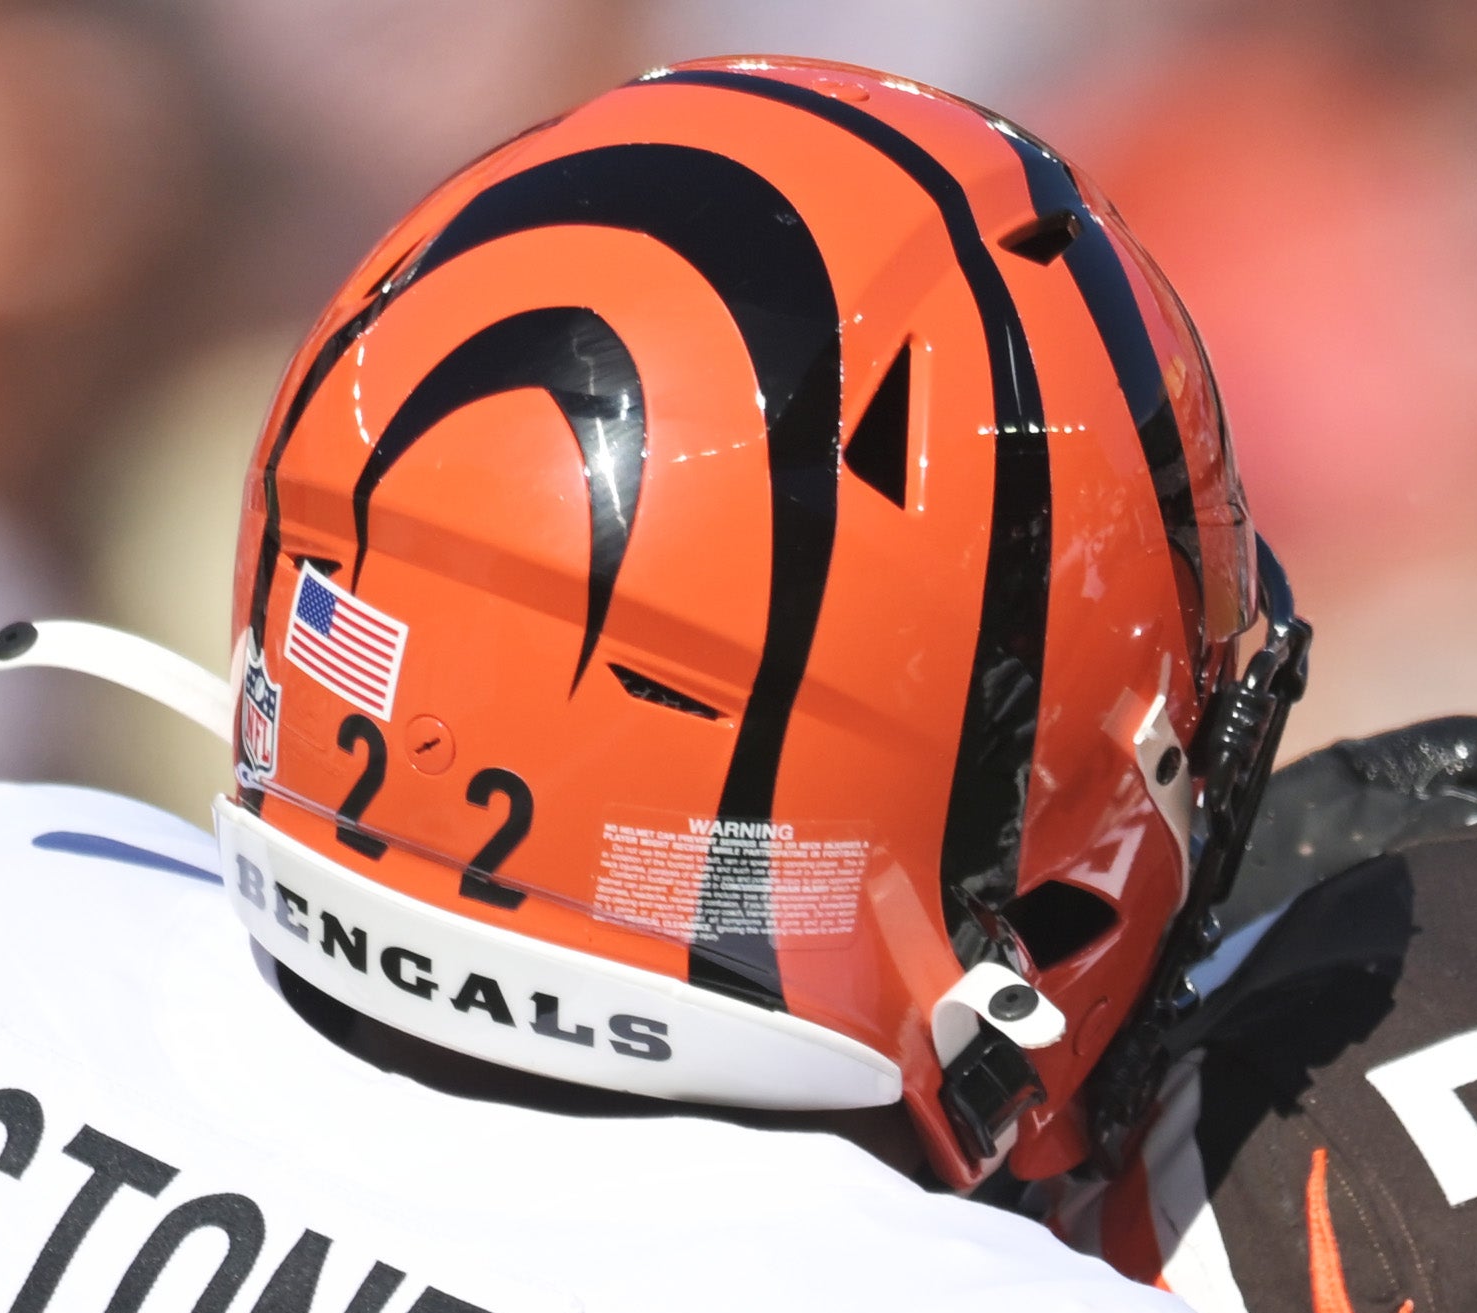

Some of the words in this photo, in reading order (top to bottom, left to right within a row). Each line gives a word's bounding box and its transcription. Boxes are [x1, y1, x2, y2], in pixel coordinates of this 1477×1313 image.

[245, 698, 270, 763] NFL
[688, 817, 794, 840] WARNING
[237, 853, 674, 1062] BENGALS
